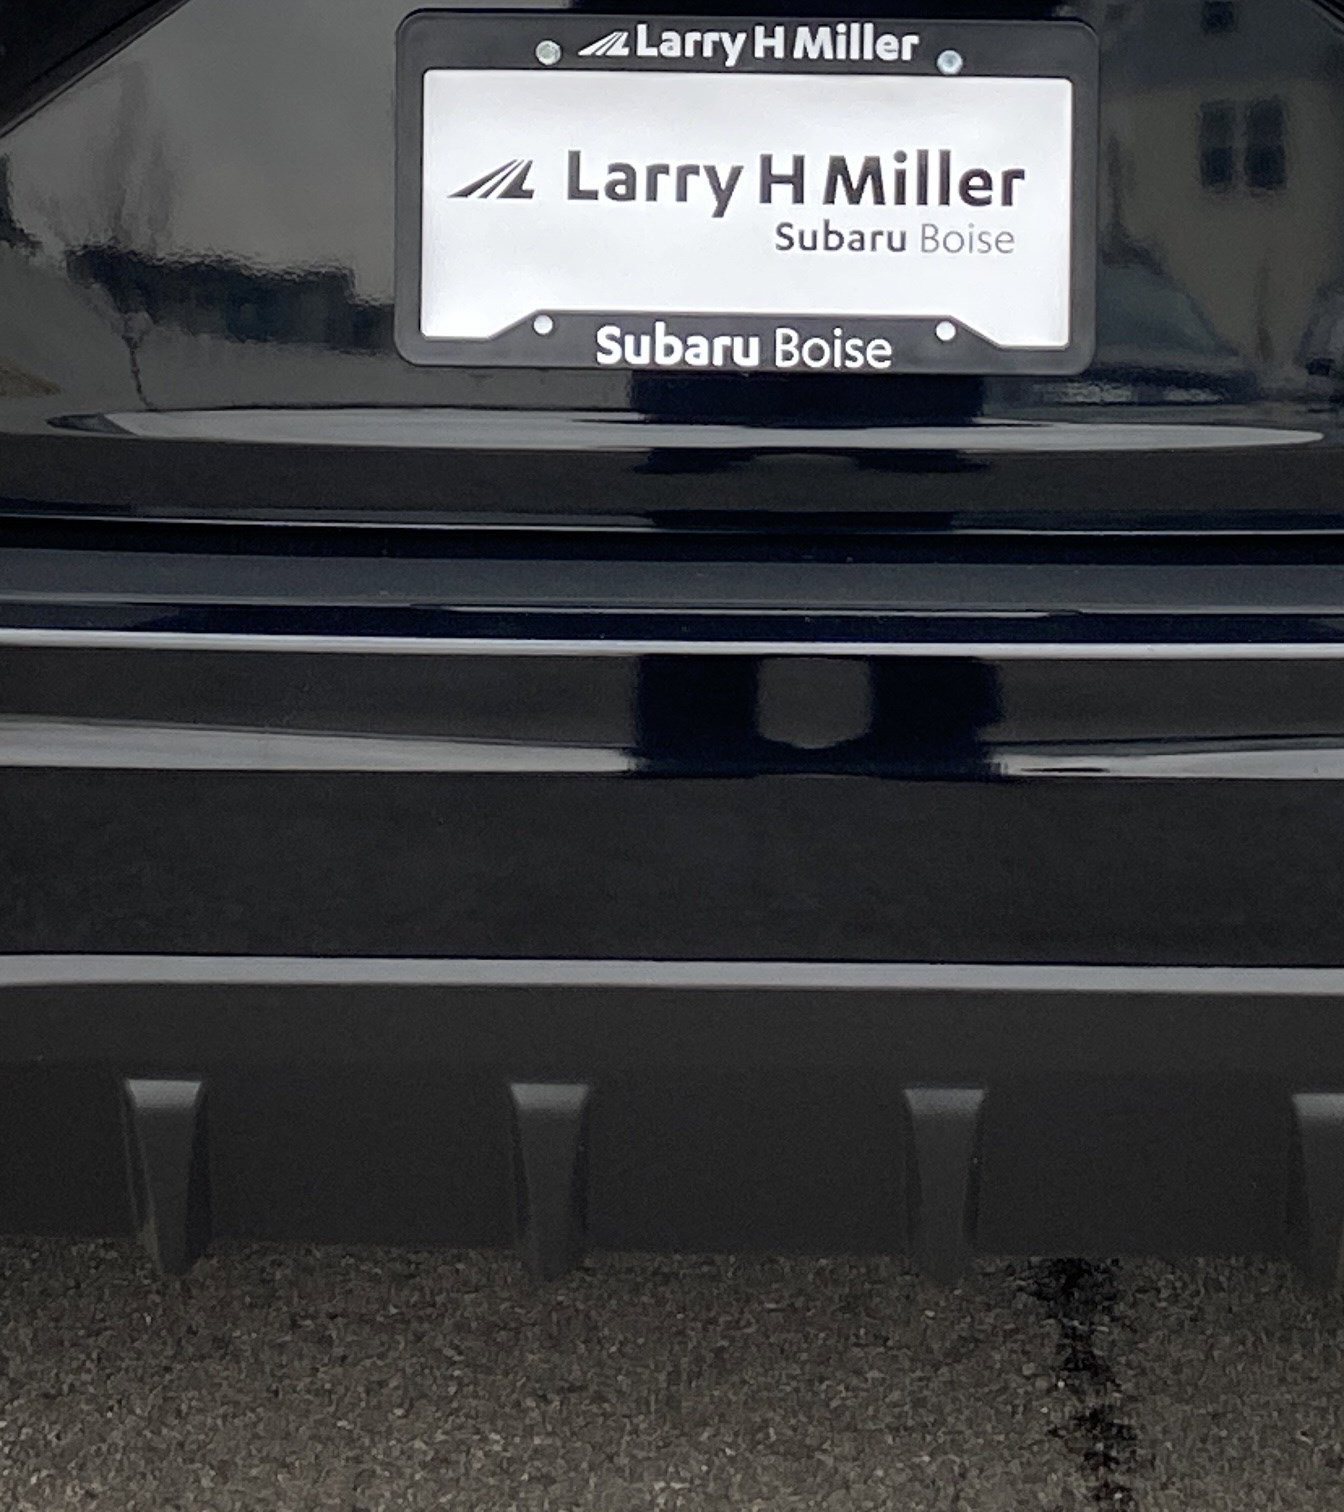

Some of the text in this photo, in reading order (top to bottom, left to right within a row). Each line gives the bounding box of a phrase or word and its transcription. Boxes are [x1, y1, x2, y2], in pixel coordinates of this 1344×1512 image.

[636, 23, 920, 67] Larry H Miller
[567, 149, 1026, 218] Larry H Miller
[775, 219, 1016, 254] Subaru Boise
[596, 321, 893, 369] Subaru Boise
